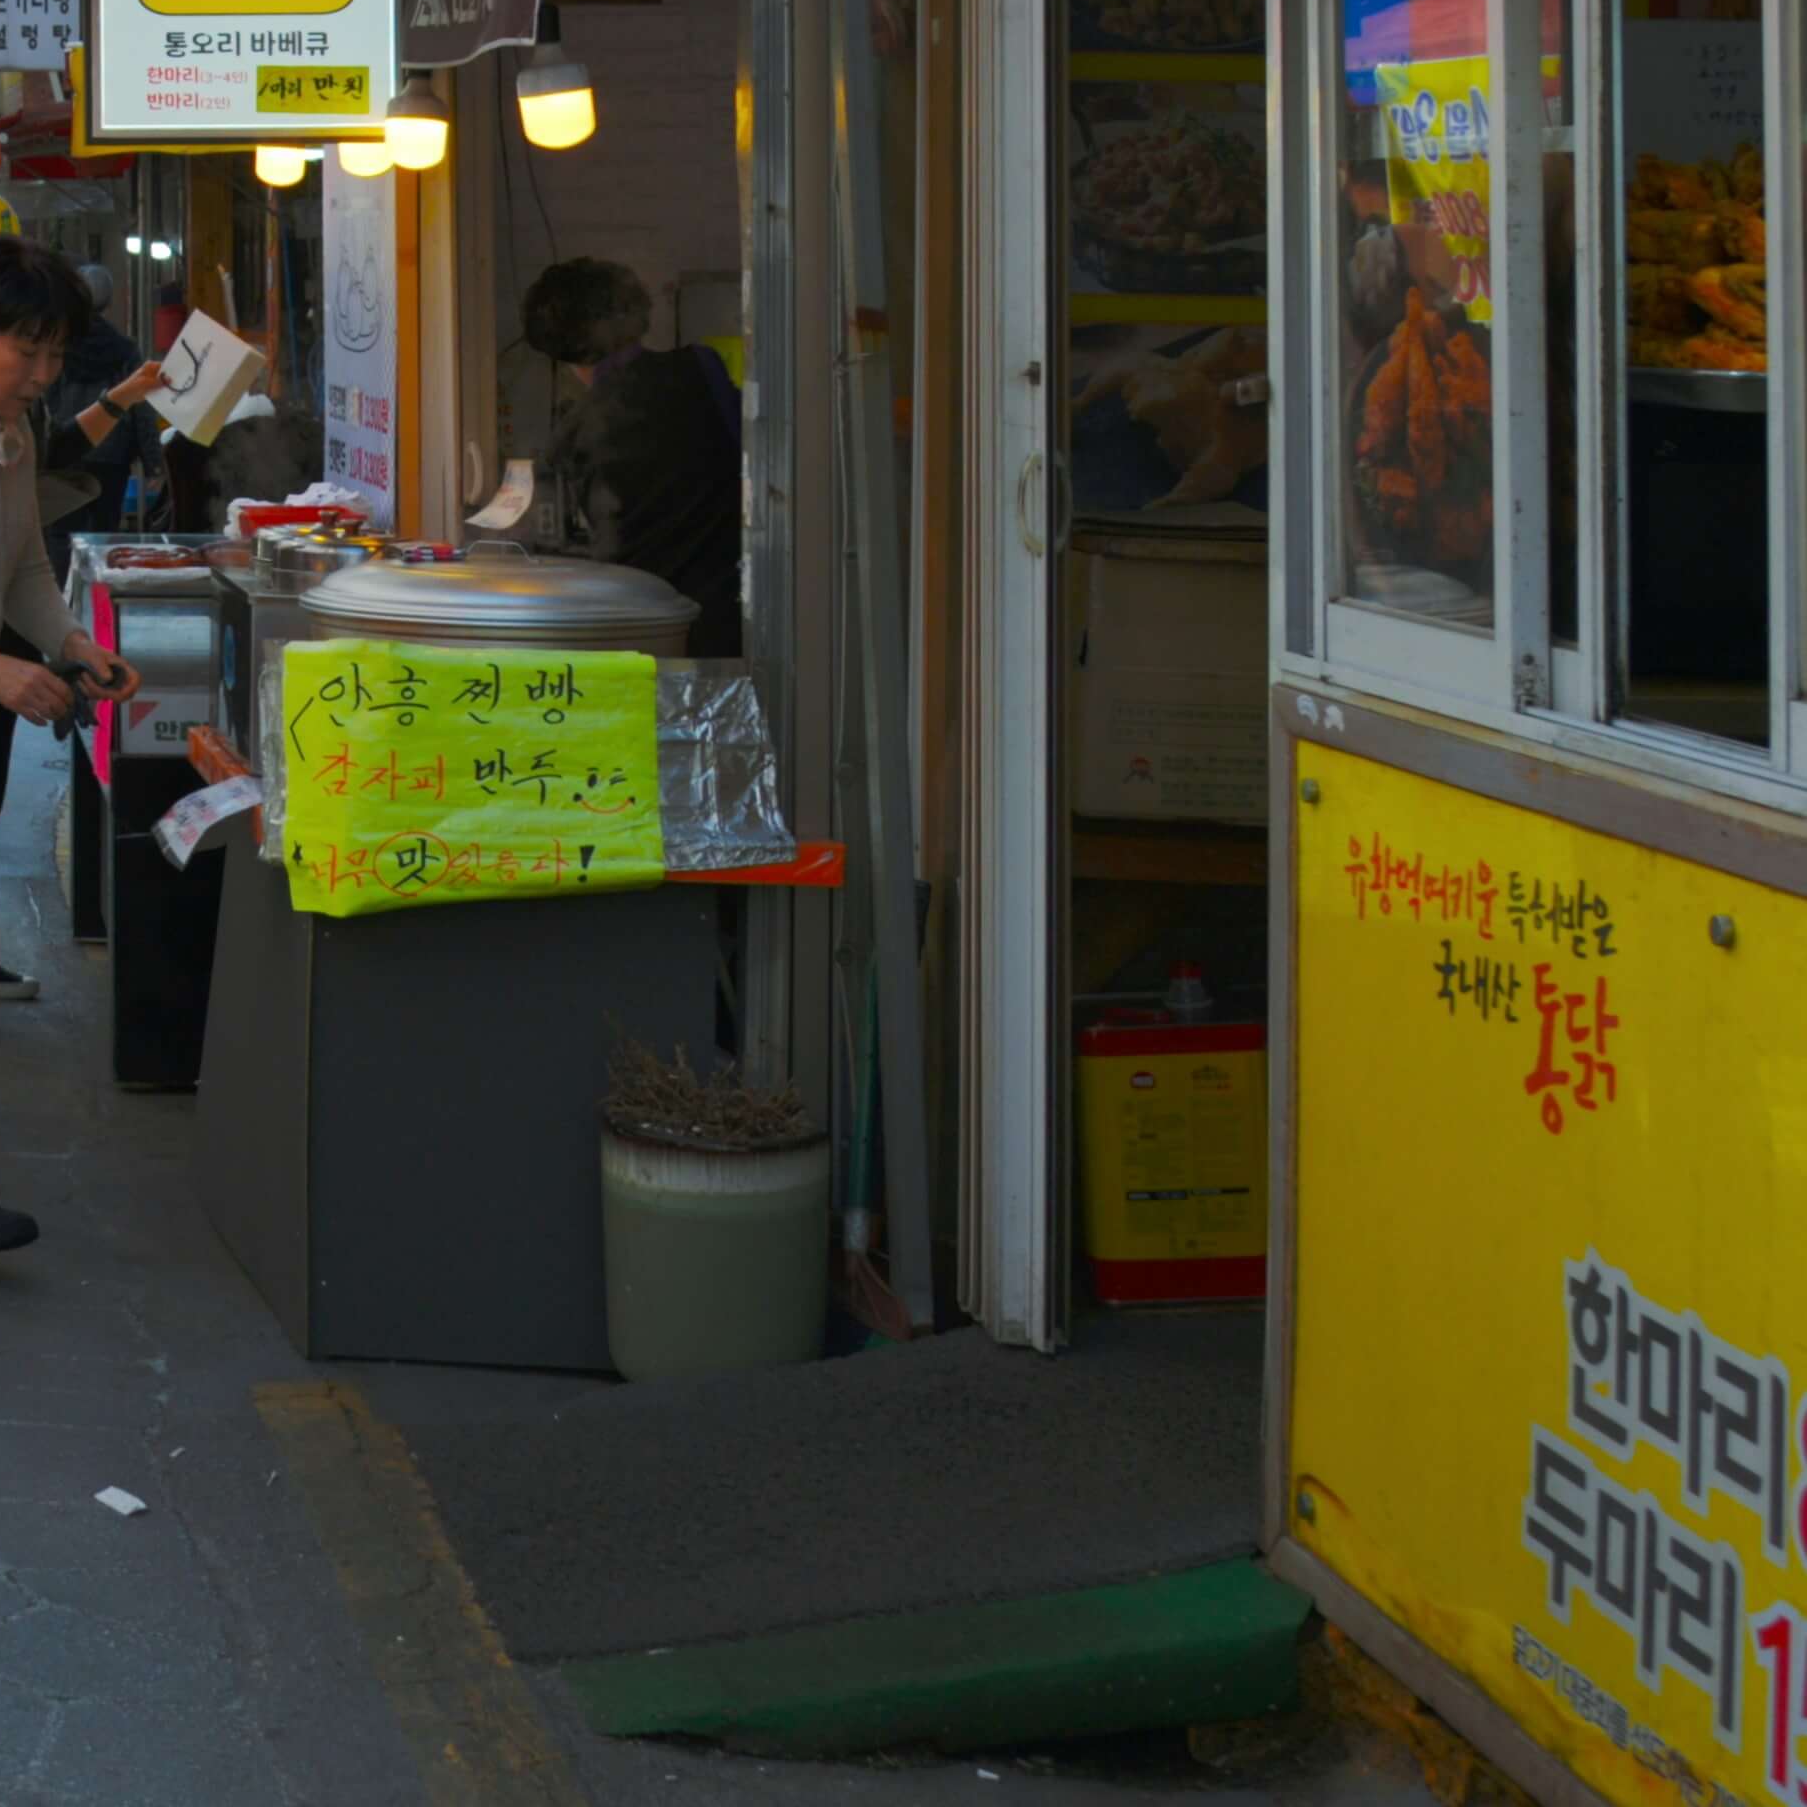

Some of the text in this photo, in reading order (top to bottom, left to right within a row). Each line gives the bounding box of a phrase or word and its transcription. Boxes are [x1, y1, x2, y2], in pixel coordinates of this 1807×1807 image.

[164, 30, 330, 59] 통오리 바베큐
[1433, 938, 1621, 1136] 국내산 통닭
[1564, 1260, 1791, 1564] 한마리
[1524, 1442, 1744, 1738] 두마리
